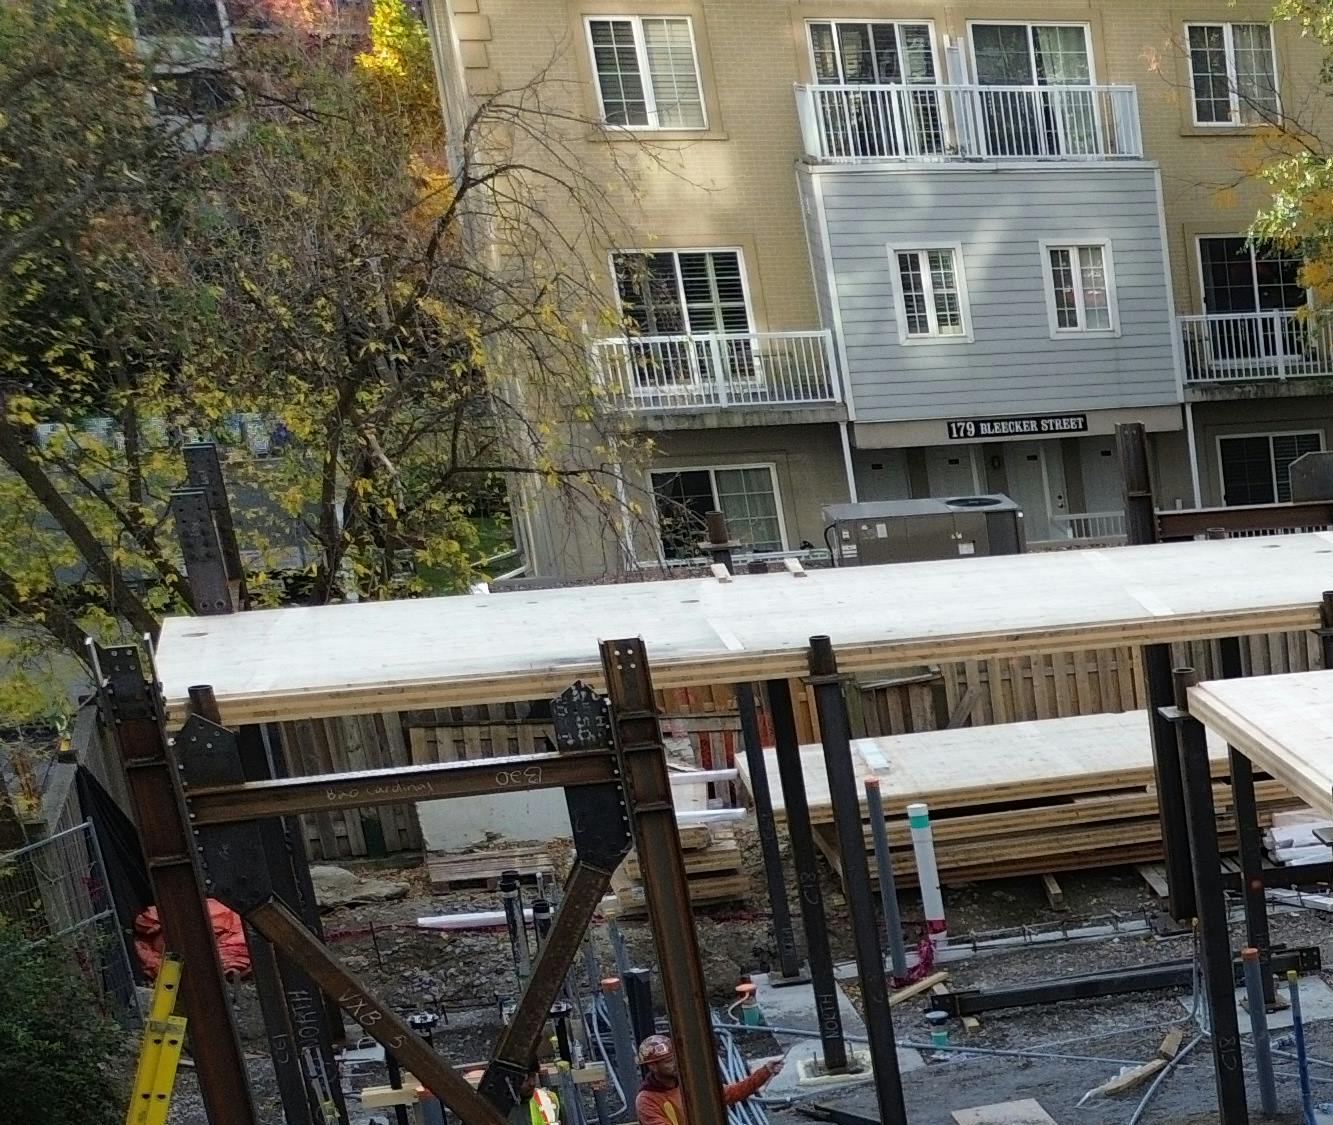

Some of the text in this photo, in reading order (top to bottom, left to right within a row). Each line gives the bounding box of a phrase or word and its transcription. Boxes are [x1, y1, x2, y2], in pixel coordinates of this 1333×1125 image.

[950, 417, 1084, 438] 179 BLEECKER STREET
[287, 989, 321, 1050] NORTH
[338, 989, 382, 1027] VXB
[818, 993, 840, 1039] NORTH
